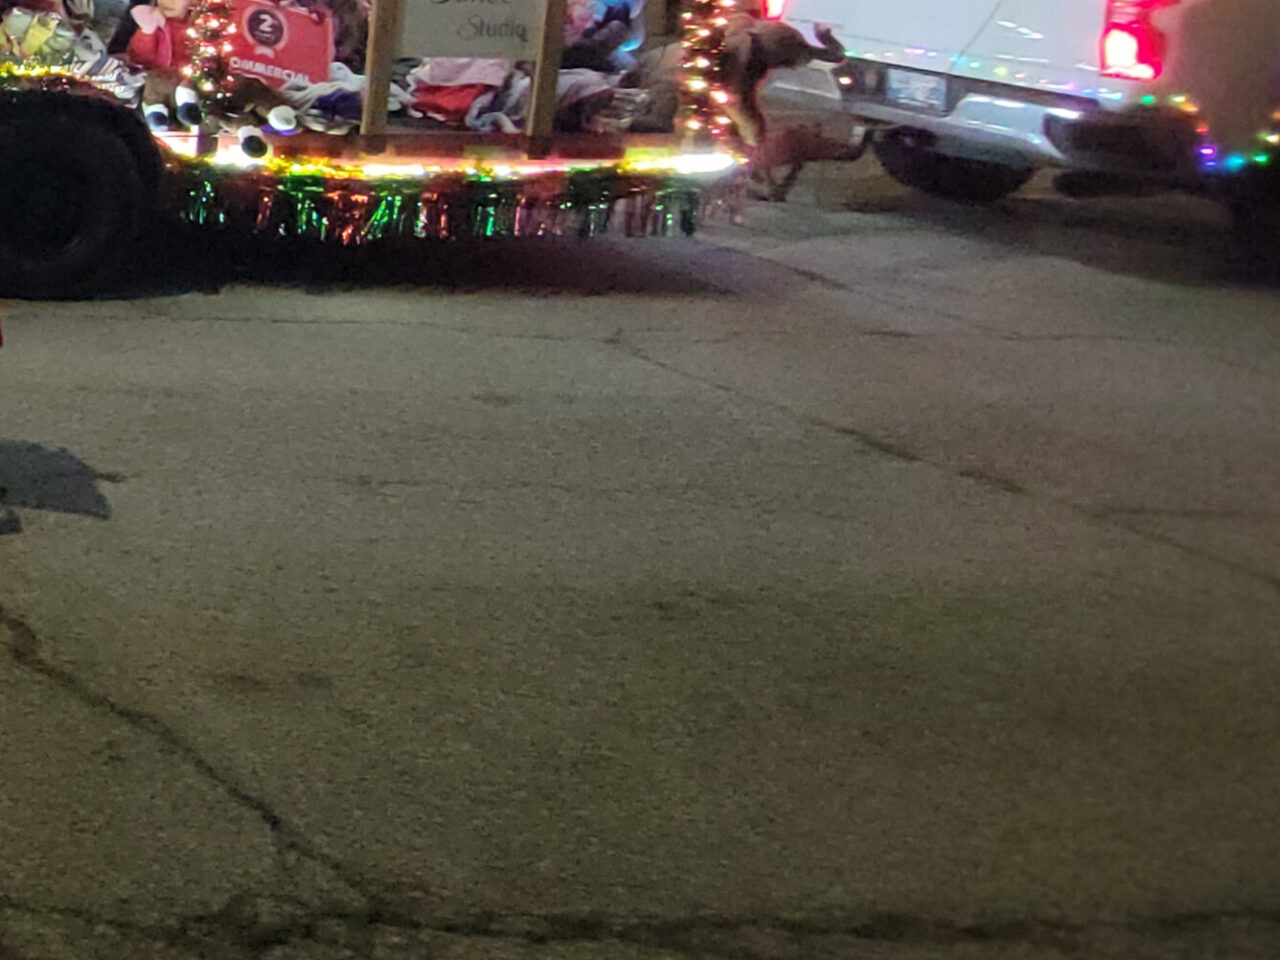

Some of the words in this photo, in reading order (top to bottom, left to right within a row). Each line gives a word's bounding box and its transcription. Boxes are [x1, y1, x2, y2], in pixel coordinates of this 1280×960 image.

[258, 14, 273, 31] 2
[457, 14, 529, 43] Studio
[228, 56, 310, 84] OMMERCIAL
